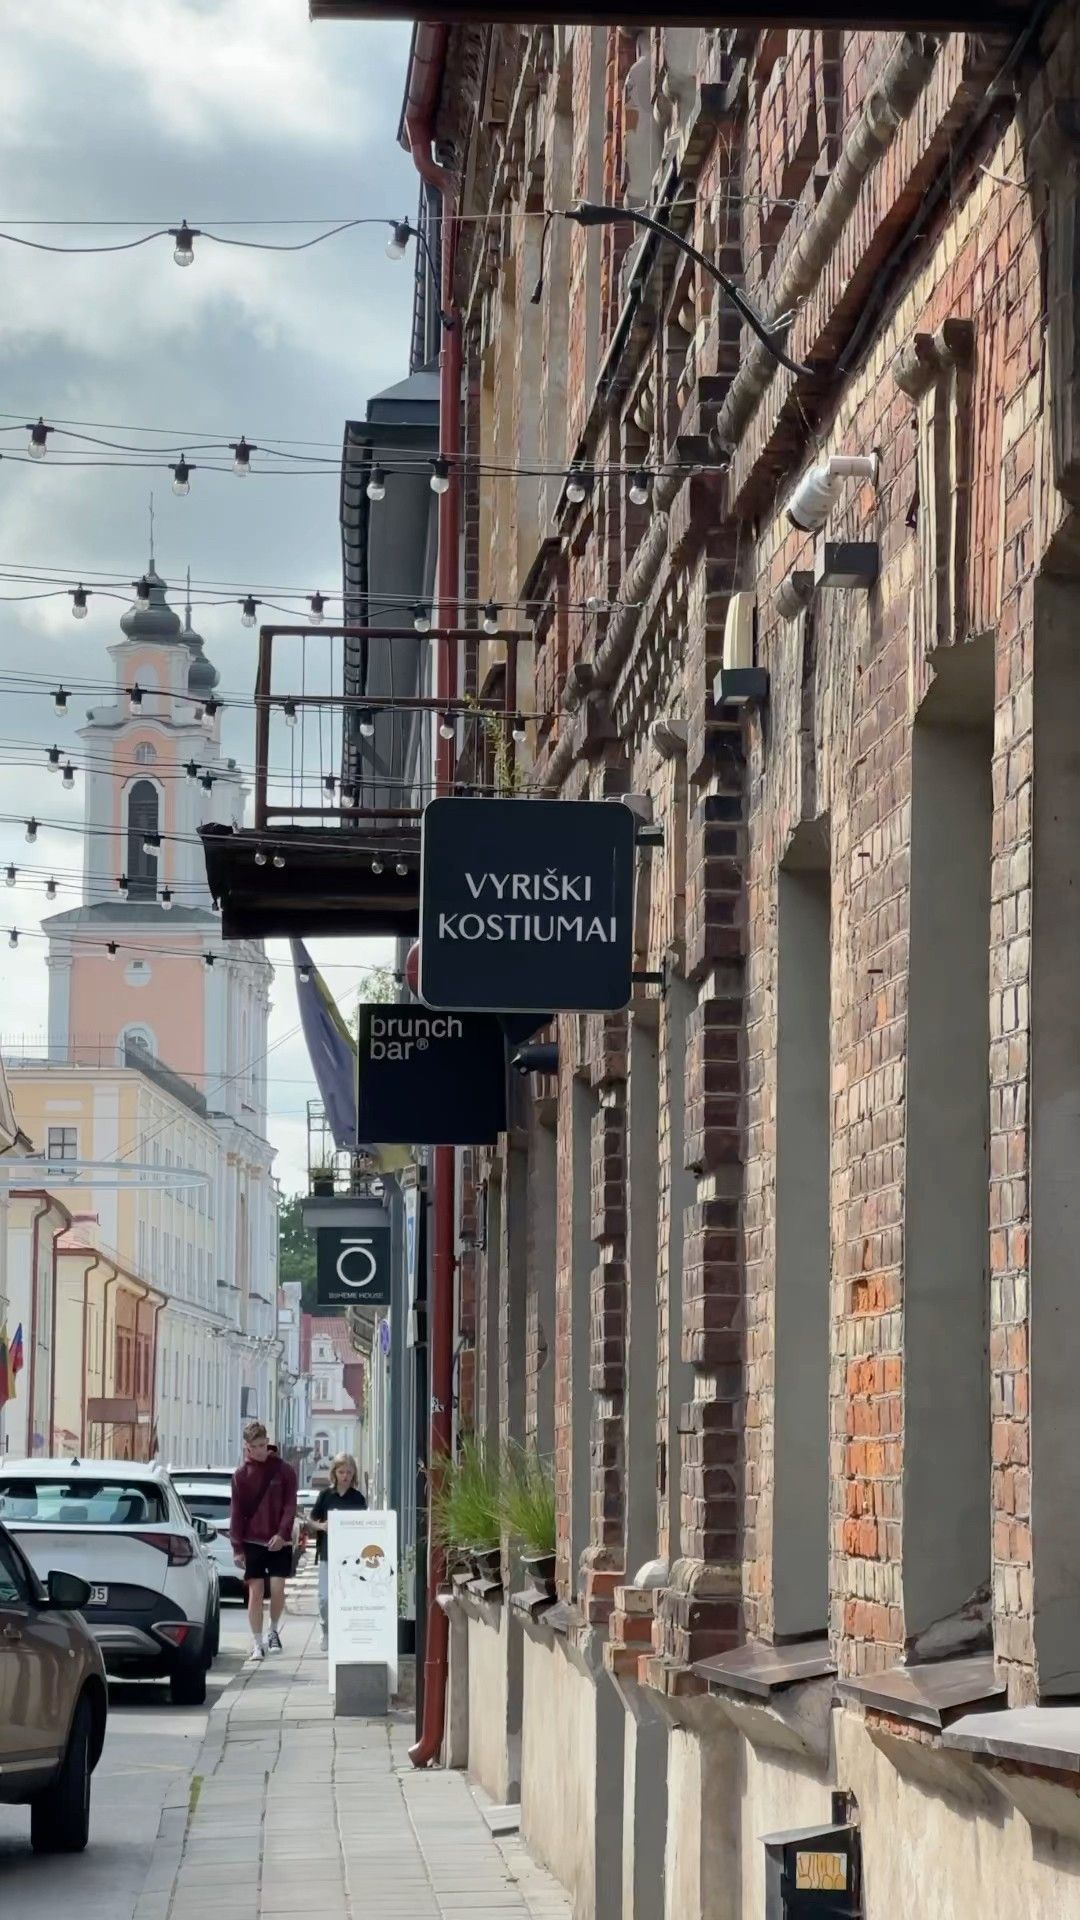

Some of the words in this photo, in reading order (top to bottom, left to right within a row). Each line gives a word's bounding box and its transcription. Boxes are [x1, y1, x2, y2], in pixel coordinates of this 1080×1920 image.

[465, 867, 592, 902] VYRIŠKI
[438, 912, 617, 943] KOSTIUMAI
[370, 1014, 463, 1038] brunch
